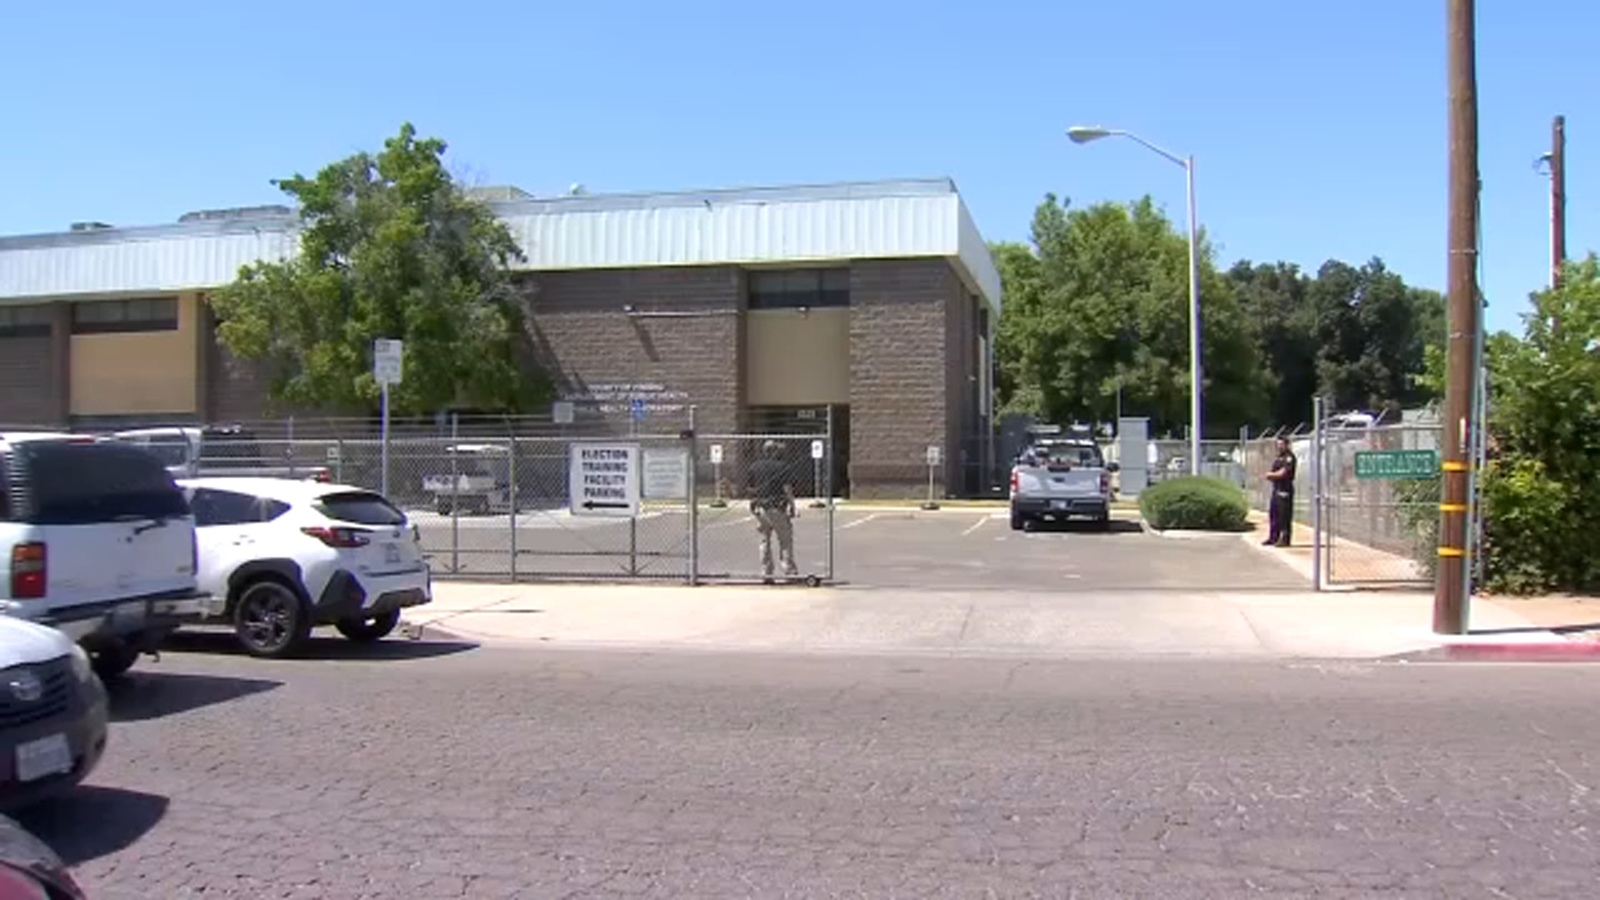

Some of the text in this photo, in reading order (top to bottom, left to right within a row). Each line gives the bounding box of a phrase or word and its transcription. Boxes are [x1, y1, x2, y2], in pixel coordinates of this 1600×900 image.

[581, 450, 628, 460] ELECTION
[581, 462, 628, 472] TRAINING
[1357, 454, 1432, 474] ENTRANCE
[584, 475, 626, 485] FACILITY
[584, 487, 626, 498] PARKING
